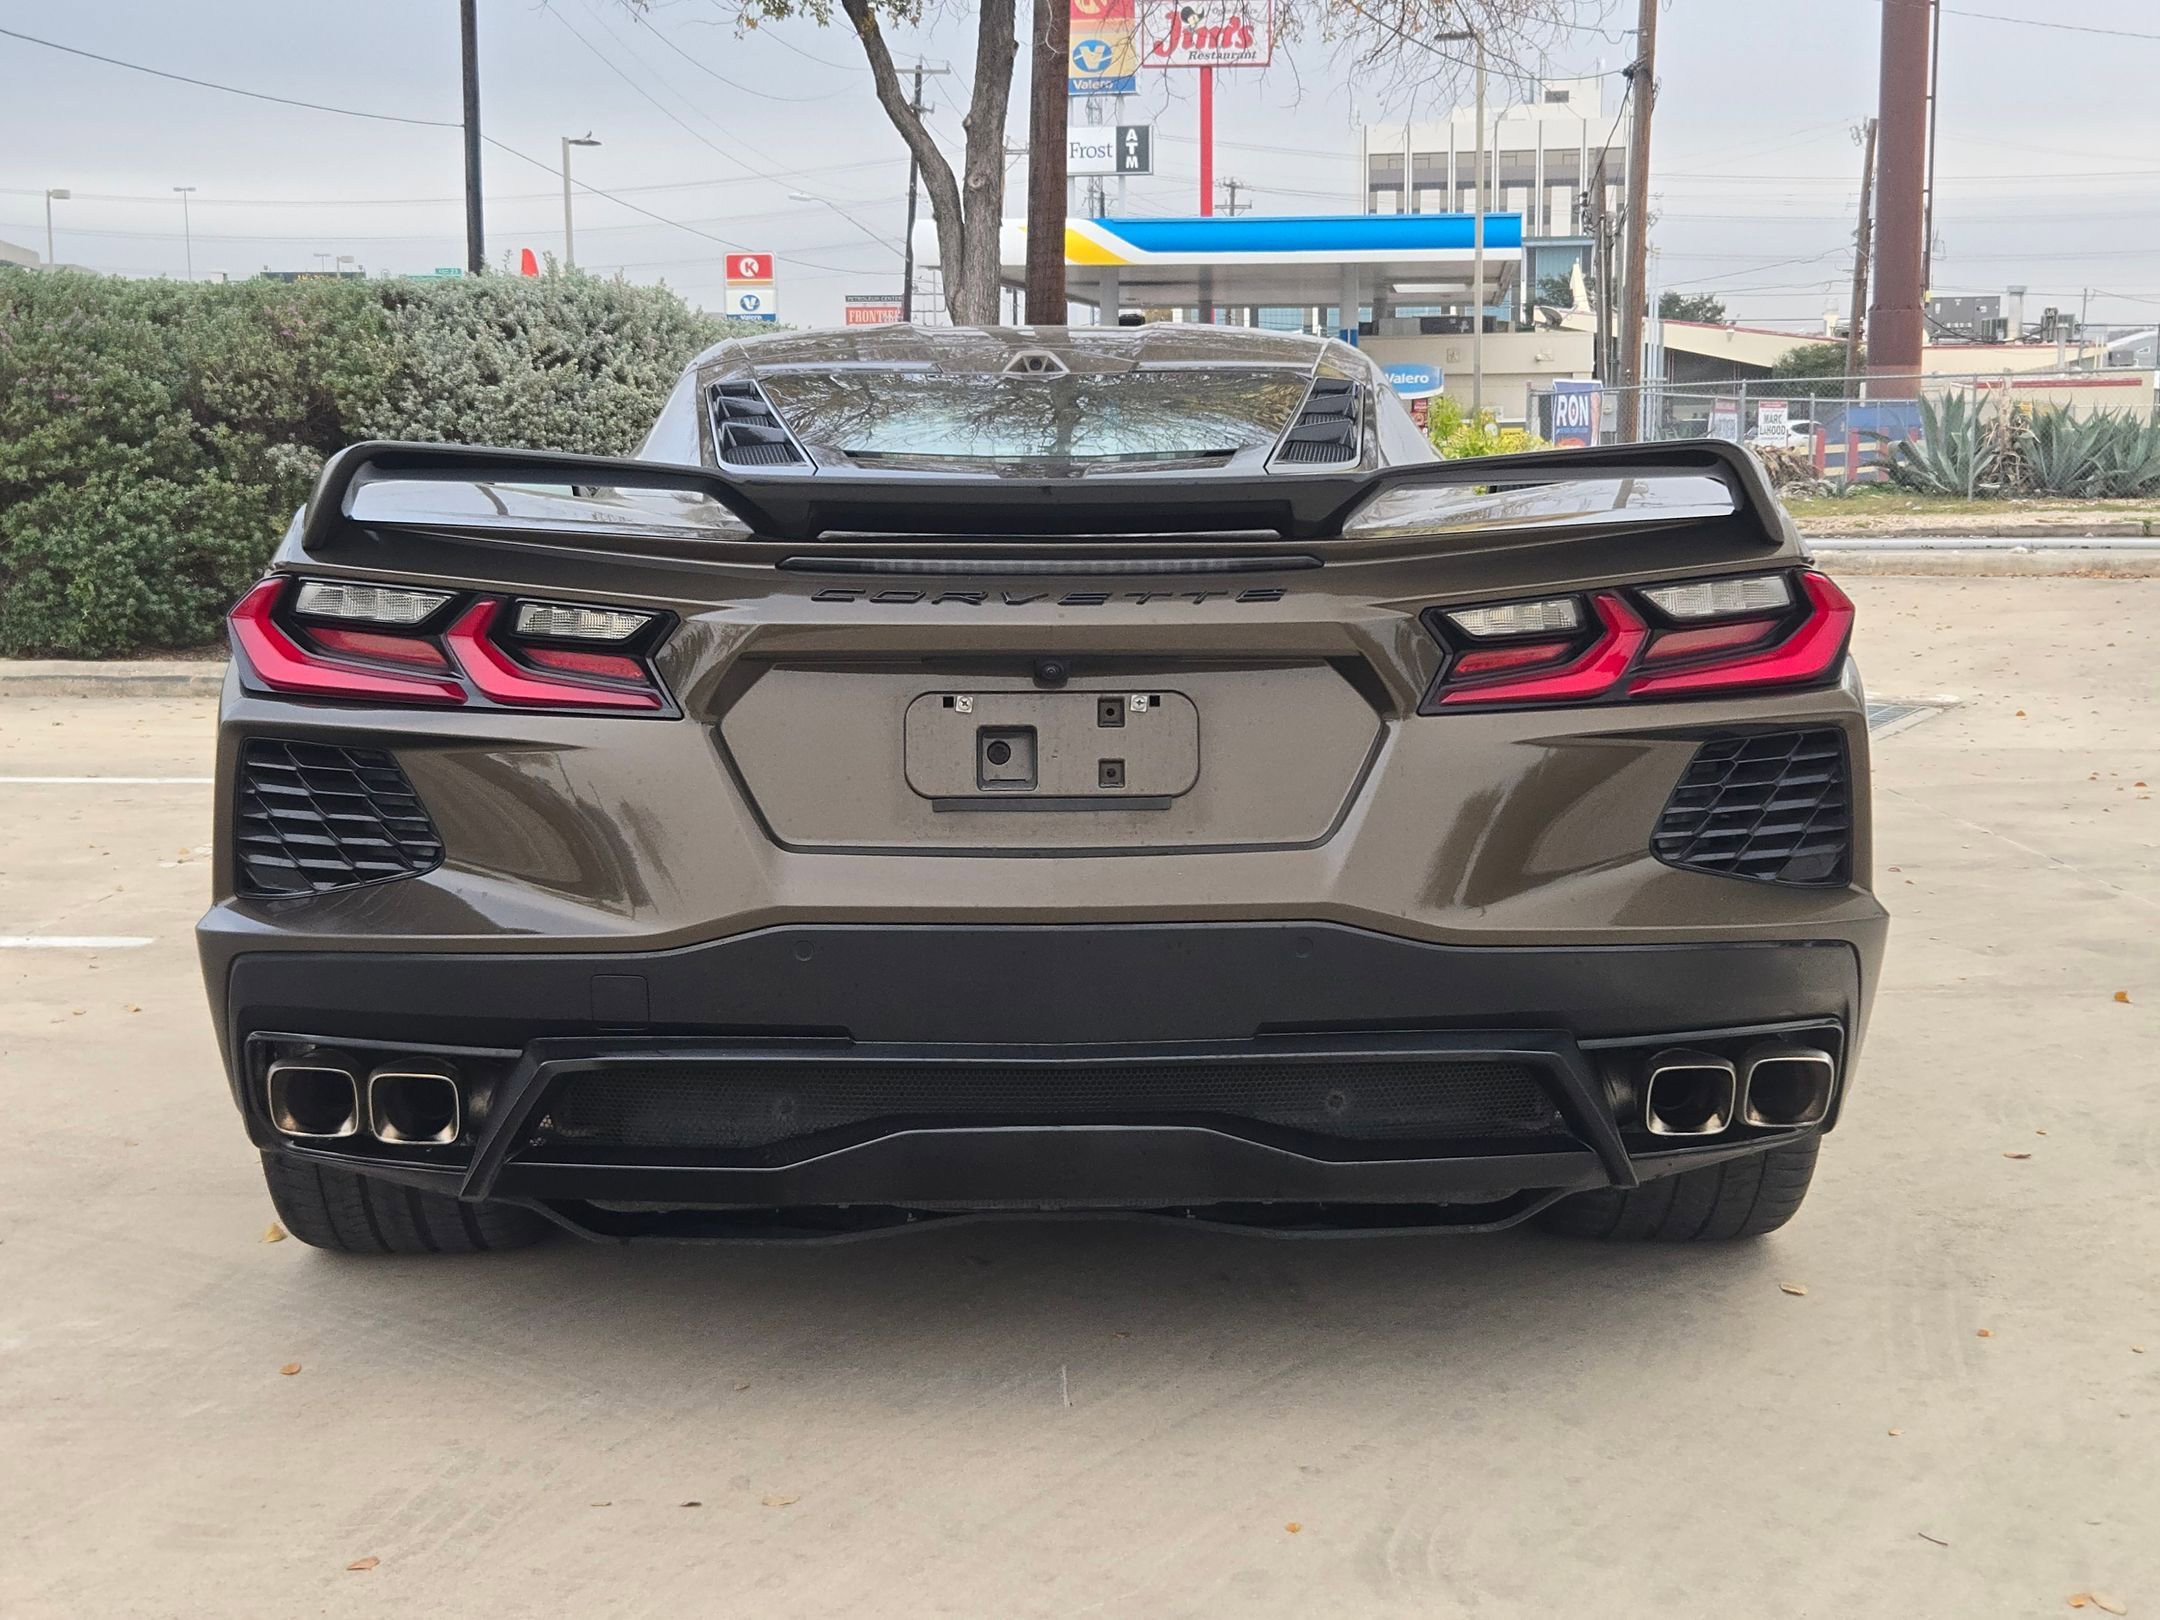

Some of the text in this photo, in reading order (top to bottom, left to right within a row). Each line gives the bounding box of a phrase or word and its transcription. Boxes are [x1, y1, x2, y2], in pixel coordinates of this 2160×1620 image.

[1153, 10, 1255, 57] Jim's
[1188, 50, 1257, 60] Restaurant
[1073, 79, 1114, 90] Valero
[1069, 142, 1113, 158] Frost
[1125, 129, 1139, 169] ATM
[1384, 373, 1429, 384] Valero
[1556, 395, 1589, 427] RON
[1763, 414, 1783, 424] MARC
[811, 587, 1288, 606] CORVETTE
